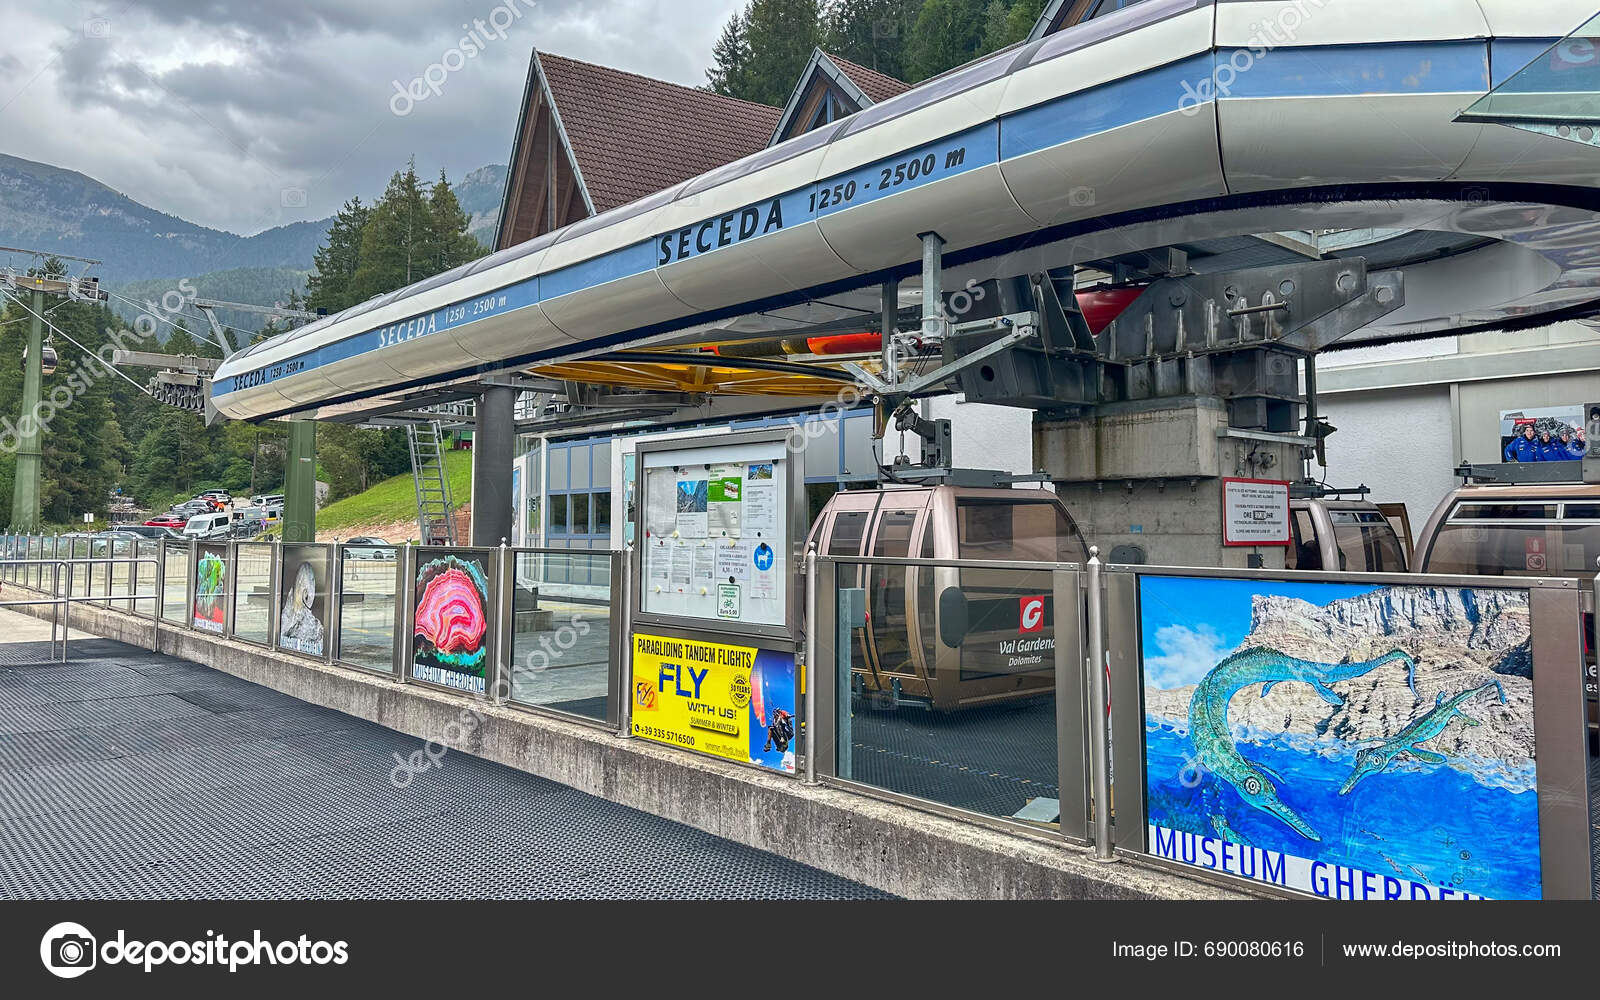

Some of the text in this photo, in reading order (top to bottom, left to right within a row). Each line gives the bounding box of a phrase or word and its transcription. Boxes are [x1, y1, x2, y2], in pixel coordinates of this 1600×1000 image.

[659, 200, 784, 266] SECEDA
[809, 180, 856, 213] 1250
[878, 153, 936, 190] 2500
[945, 147, 966, 169] m
[379, 314, 437, 347] SECEDA
[445, 309, 466, 324] 1250
[473, 299, 496, 315] 2500
[498, 294, 507, 307] m
[232, 369, 266, 391] SECEDA
[270, 366, 282, 379] 1250
[286, 361, 299, 375] 2500
[1022, 600, 1042, 629] G
[638, 638, 752, 669] PARAGLIDING TANDEM FLIGHTS
[1000, 640, 1015, 655] Val
[1009, 655, 1042, 667] Dolomites
[414, 664, 441, 684] MUSEUM
[658, 662, 710, 700] FLY
[737, 685, 751, 695] YEARS
[687, 701, 716, 717] WITH
[640, 725, 696, 747] +39 335 5716500
[690, 716, 712, 728] SUMMER
[717, 722, 736, 732] WINTER
[1155, 826, 1286, 885] MUSEUM
